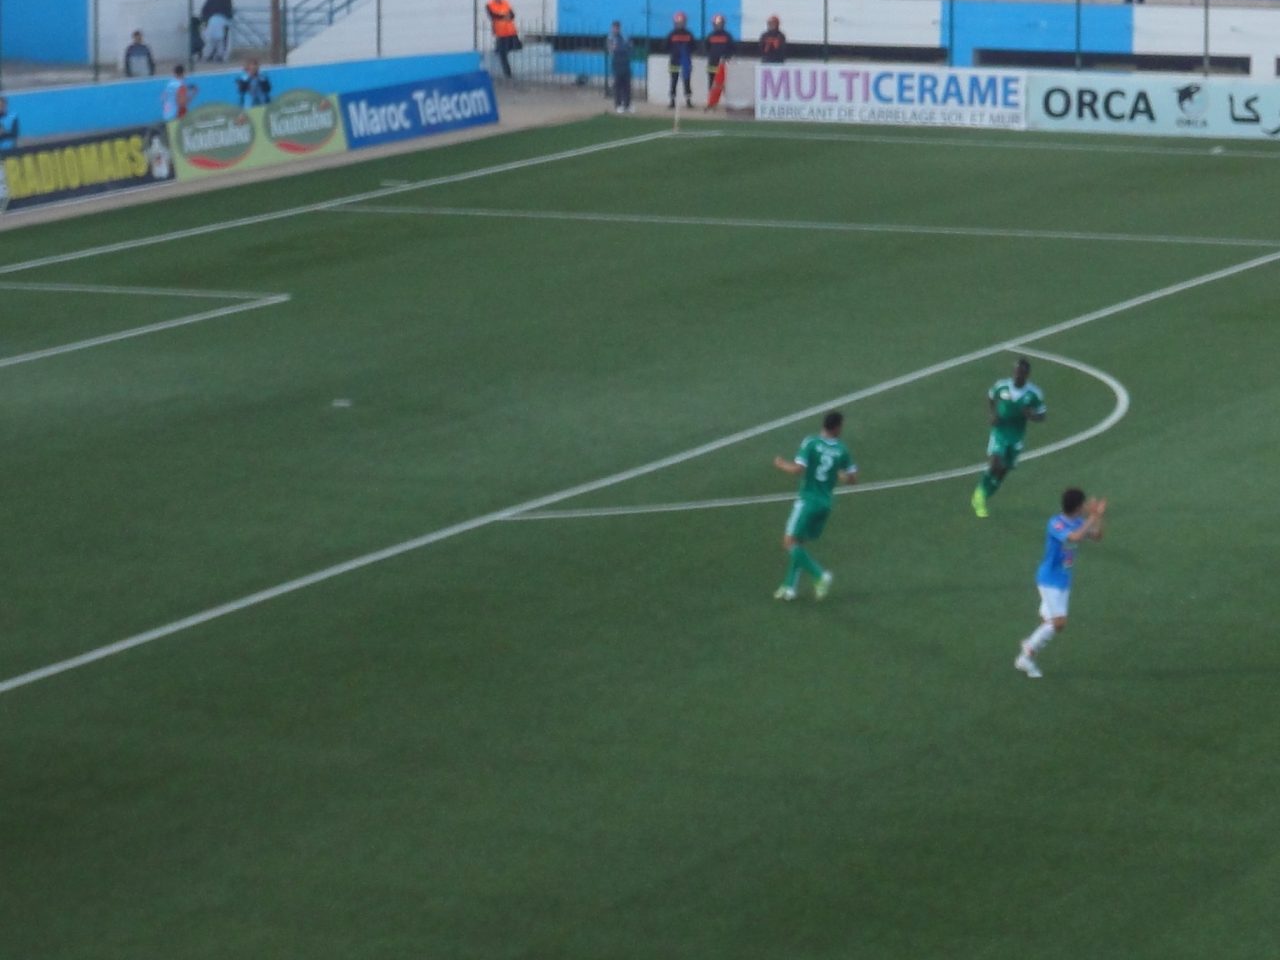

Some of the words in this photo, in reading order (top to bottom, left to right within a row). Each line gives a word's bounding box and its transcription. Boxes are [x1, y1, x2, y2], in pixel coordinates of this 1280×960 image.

[760, 69, 1020, 108] MULTICERAME
[1043, 88, 1156, 122] ORCA
[348, 99, 412, 138] Maroc
[412, 86, 492, 127] Telecom
